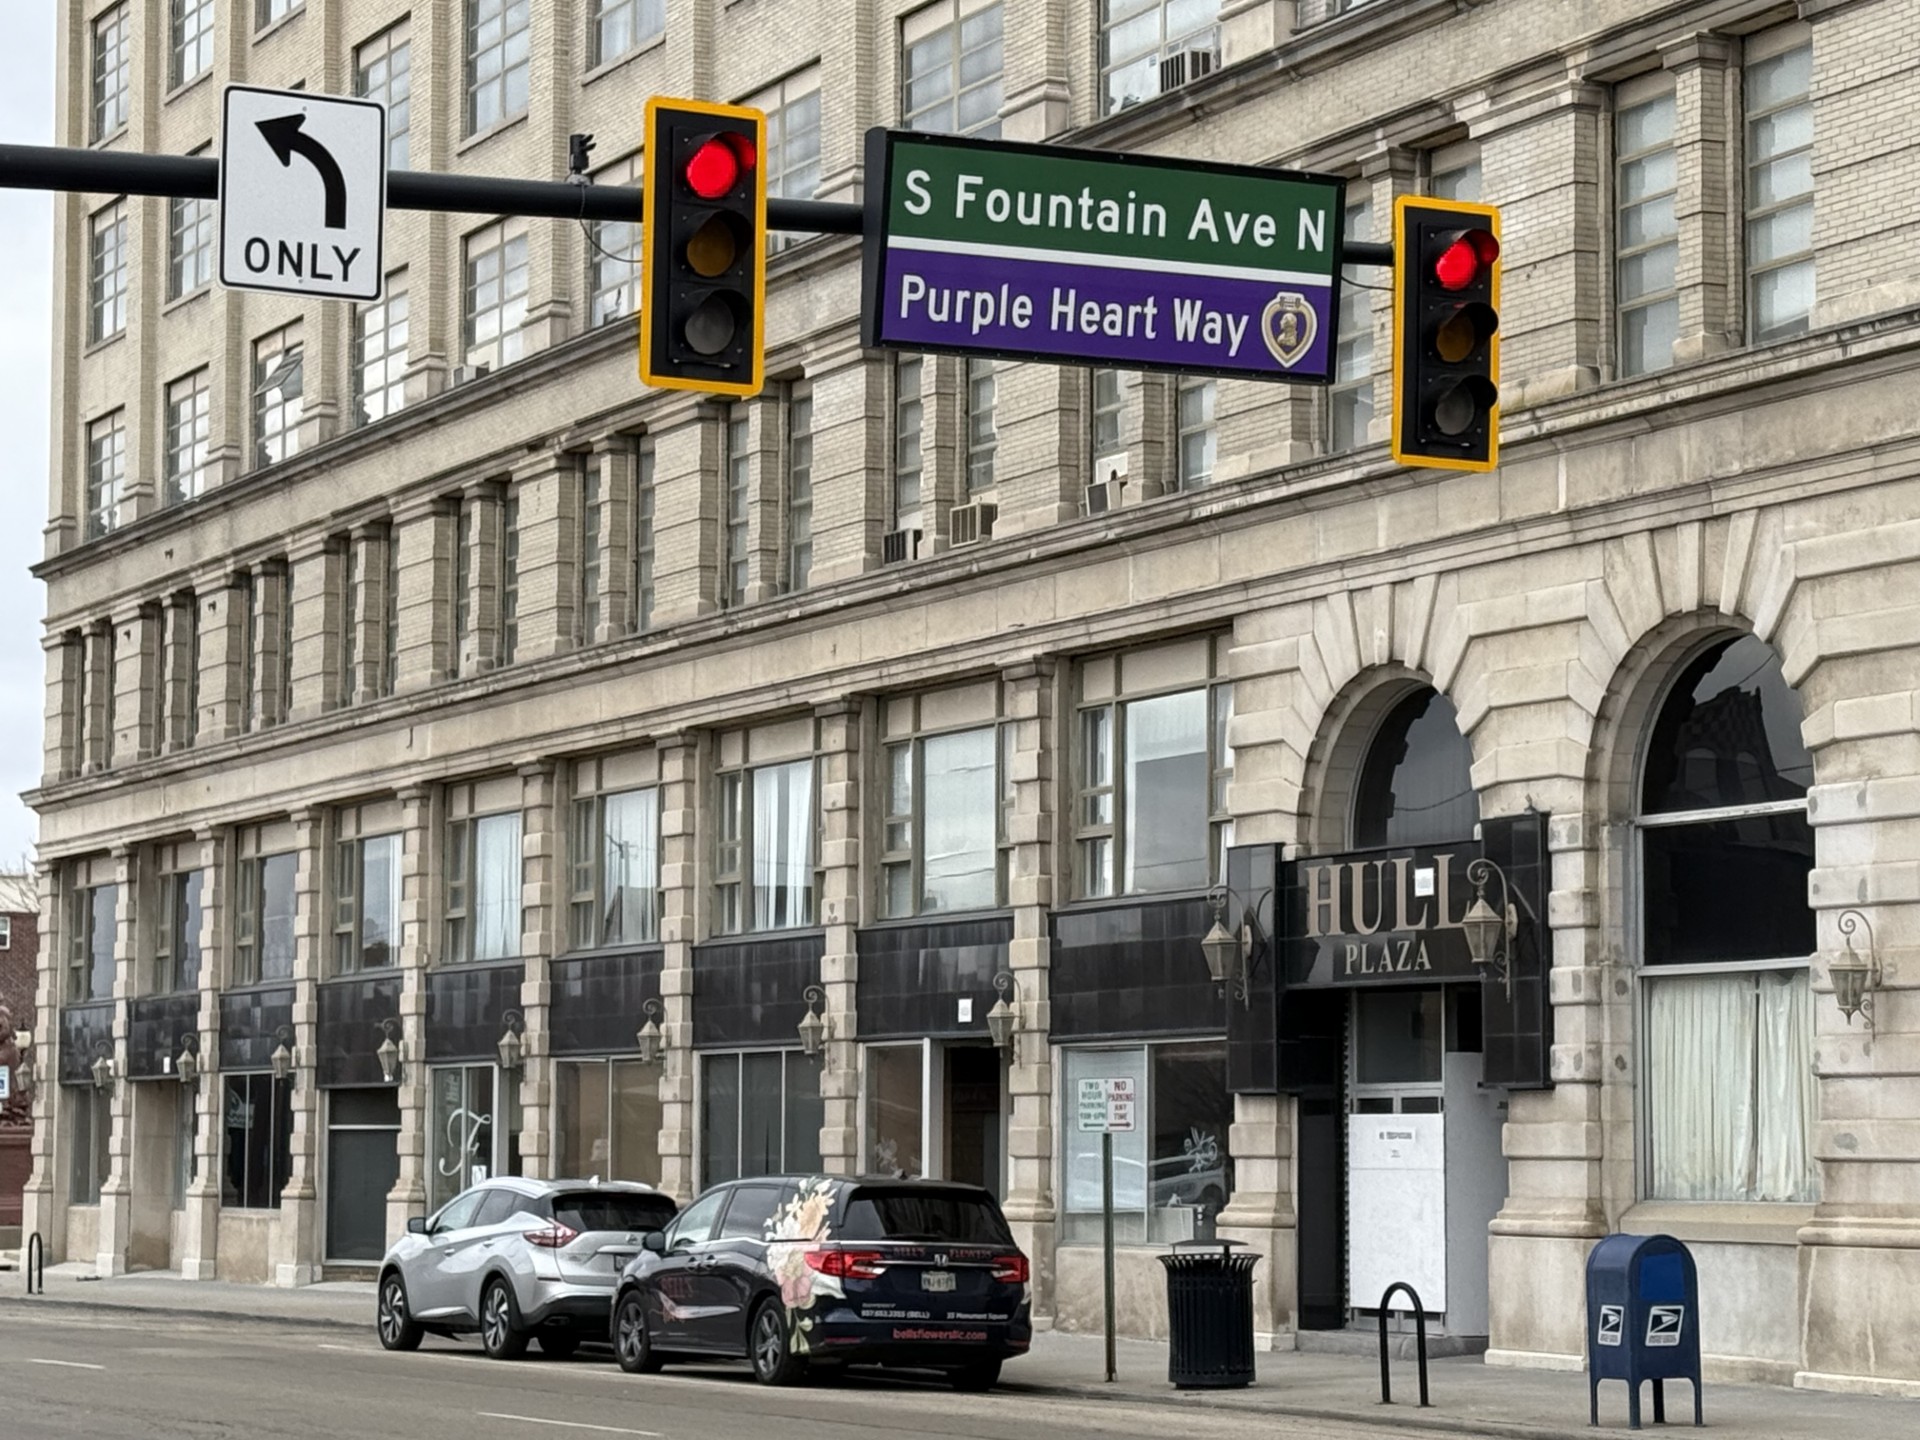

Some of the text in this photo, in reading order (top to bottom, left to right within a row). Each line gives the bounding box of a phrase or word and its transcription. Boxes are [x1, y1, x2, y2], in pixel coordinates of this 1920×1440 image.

[903, 169, 1326, 253] S Fountain Ave N
[244, 236, 361, 282] ONLY
[900, 274, 1249, 357] Purple Heart Way
[1304, 853, 1471, 939] HULL
[1344, 939, 1432, 976] PLAZA
[1114, 1080, 1127, 1091] NO
